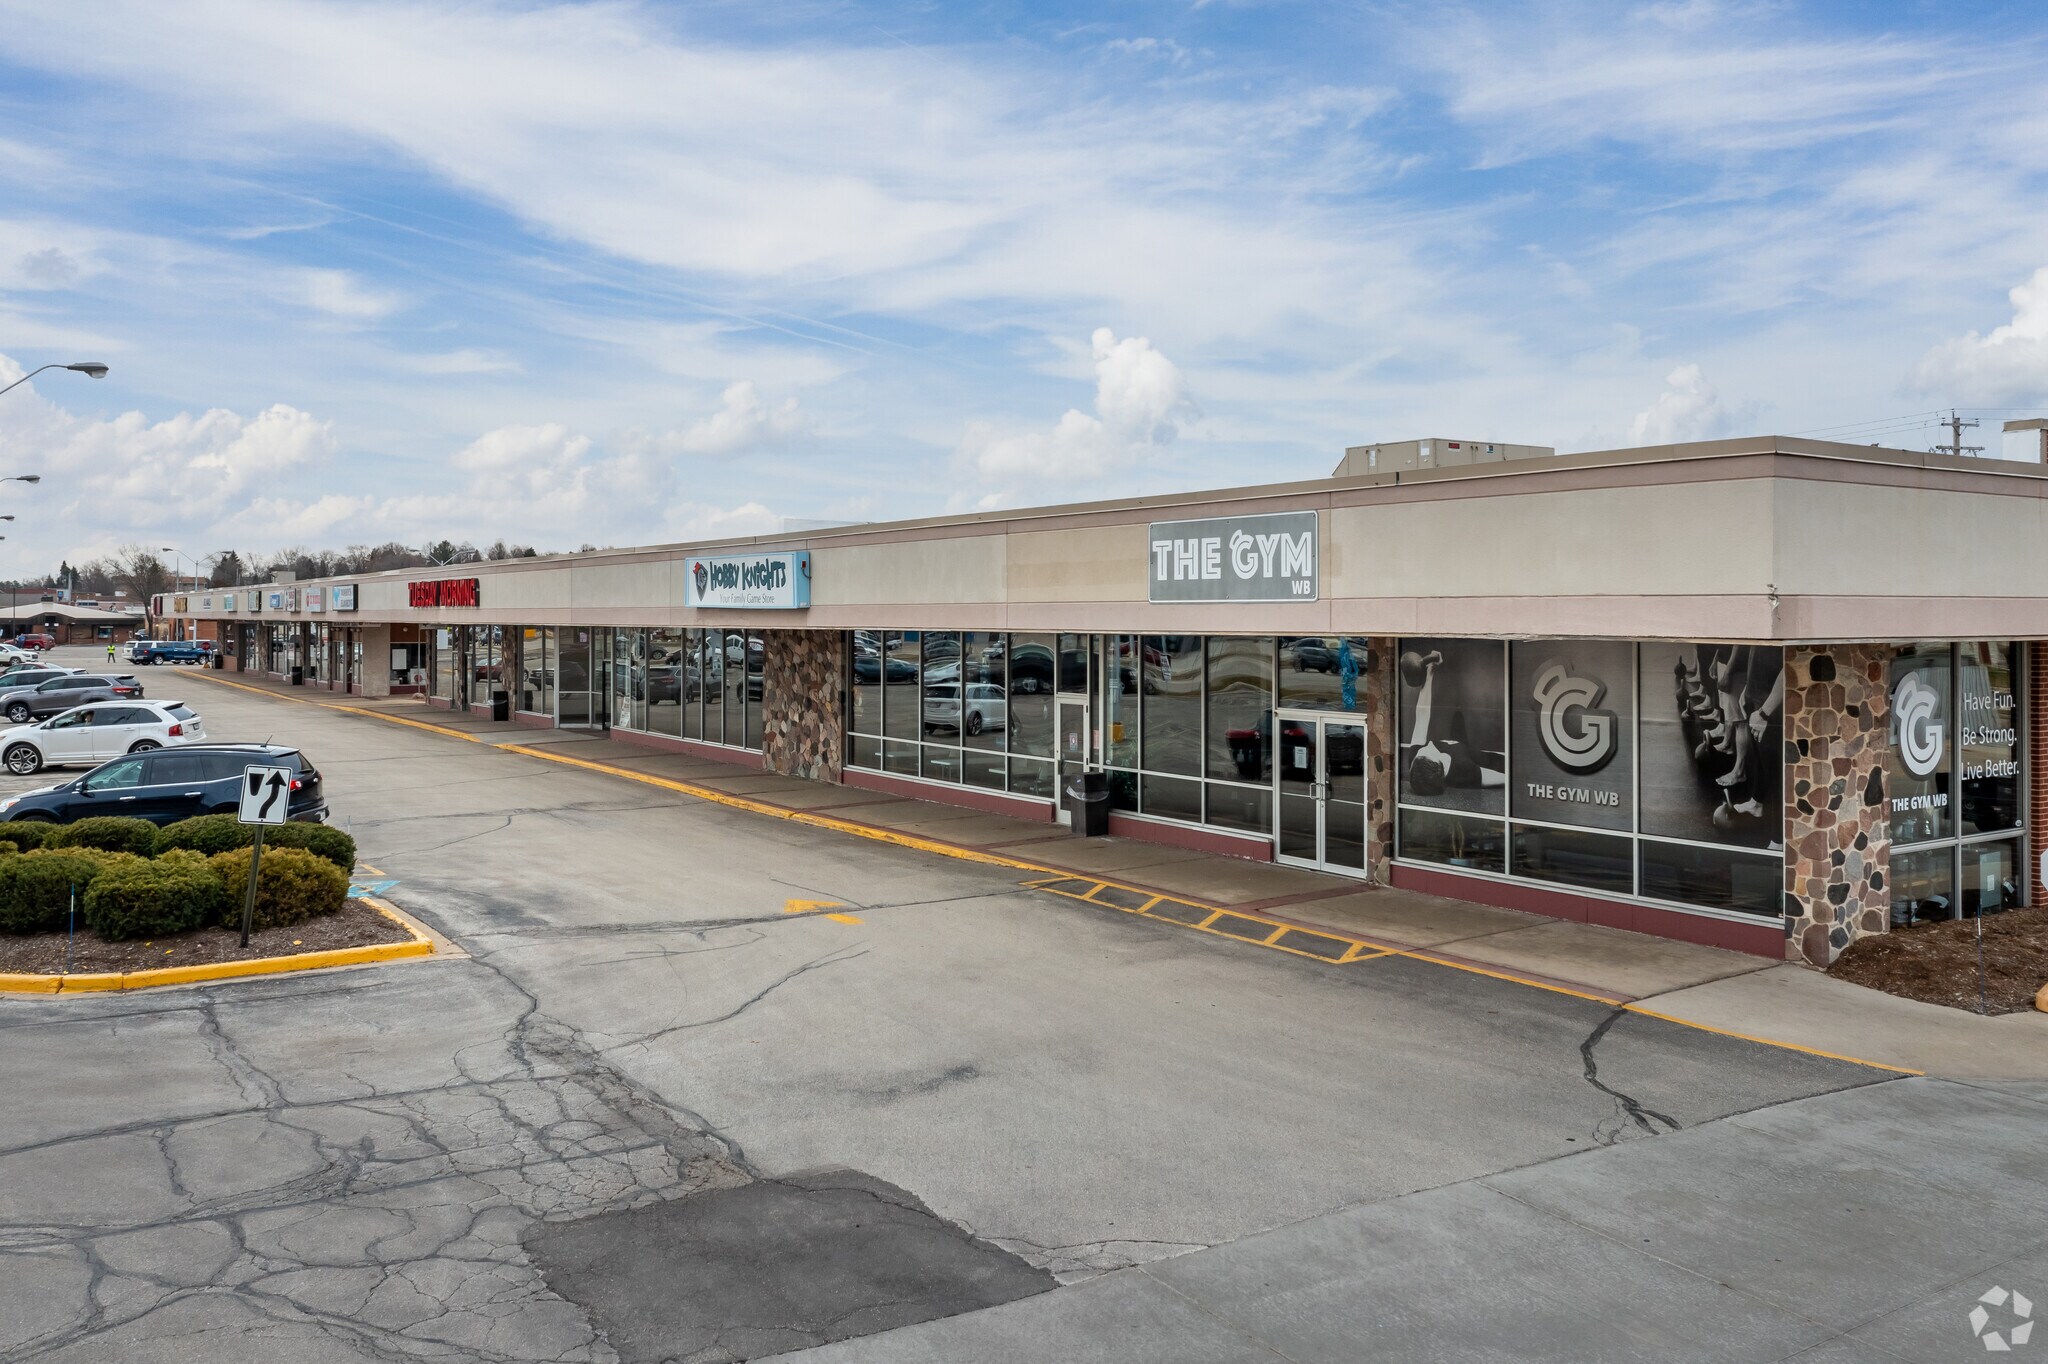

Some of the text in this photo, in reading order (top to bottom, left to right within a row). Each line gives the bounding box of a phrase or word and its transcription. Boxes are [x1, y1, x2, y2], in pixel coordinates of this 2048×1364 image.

[1152, 529, 1312, 581] THE GYM
[710, 561, 740, 591] HOBBY
[1291, 580, 1311, 595] WB
[720, 593, 775, 604] Your Family Game Store
[1964, 690, 2016, 710] Have Fun.
[1963, 726, 2017, 748] Be Strong.
[1961, 760, 2020, 781] Live Better.
[1527, 783, 1620, 807] THE GYM WB
[1892, 793, 1948, 812] THE GYM WB
